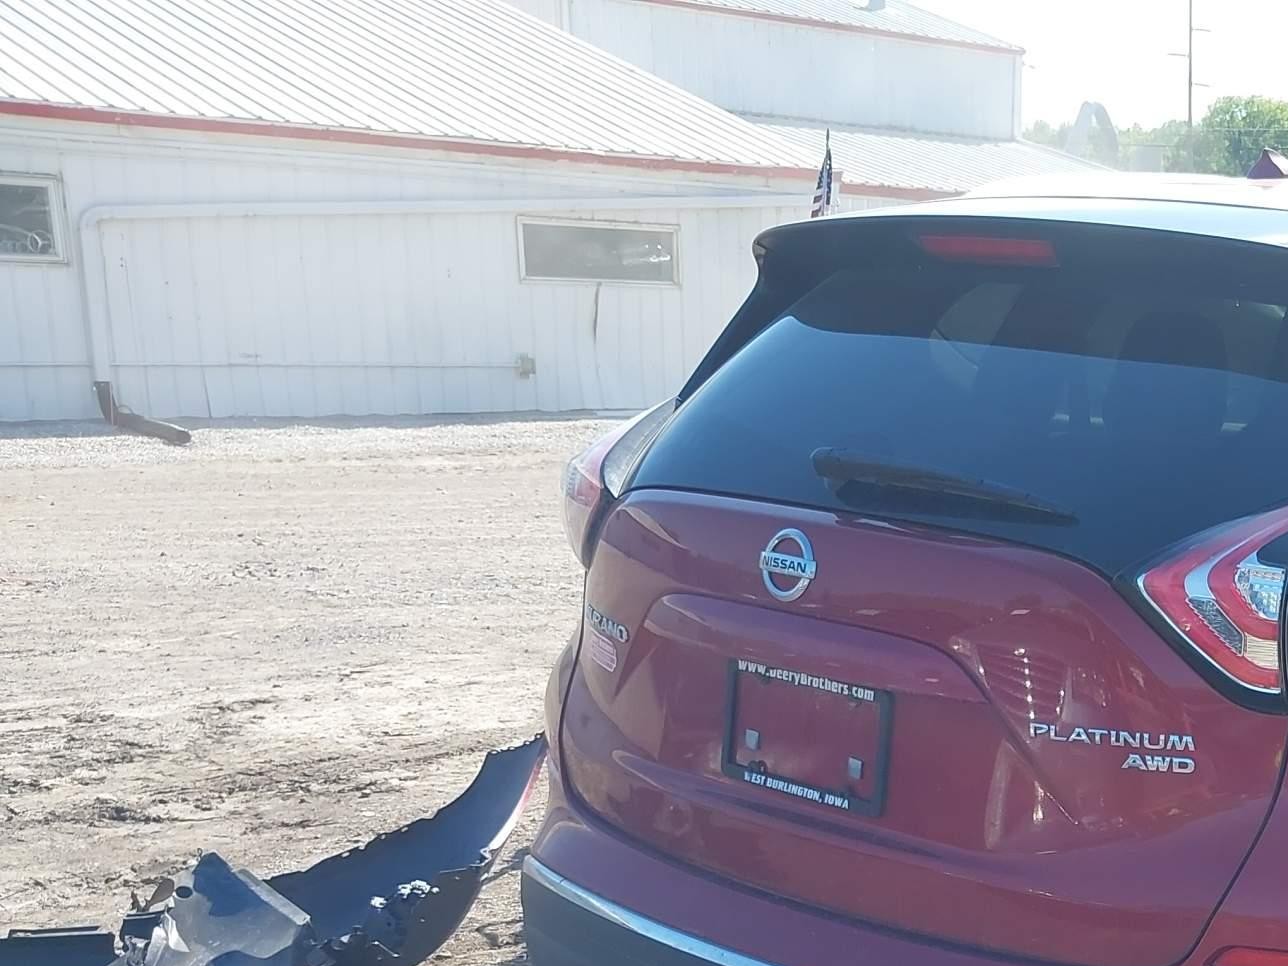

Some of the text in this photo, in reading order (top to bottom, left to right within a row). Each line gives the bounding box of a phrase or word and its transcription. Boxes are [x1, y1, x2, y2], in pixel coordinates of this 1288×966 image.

[762, 555, 808, 574] NISSAN
[1029, 722, 1195, 751] PLATINUM
[1121, 753, 1195, 774] AWD
[824, 793, 849, 810] IOWA
